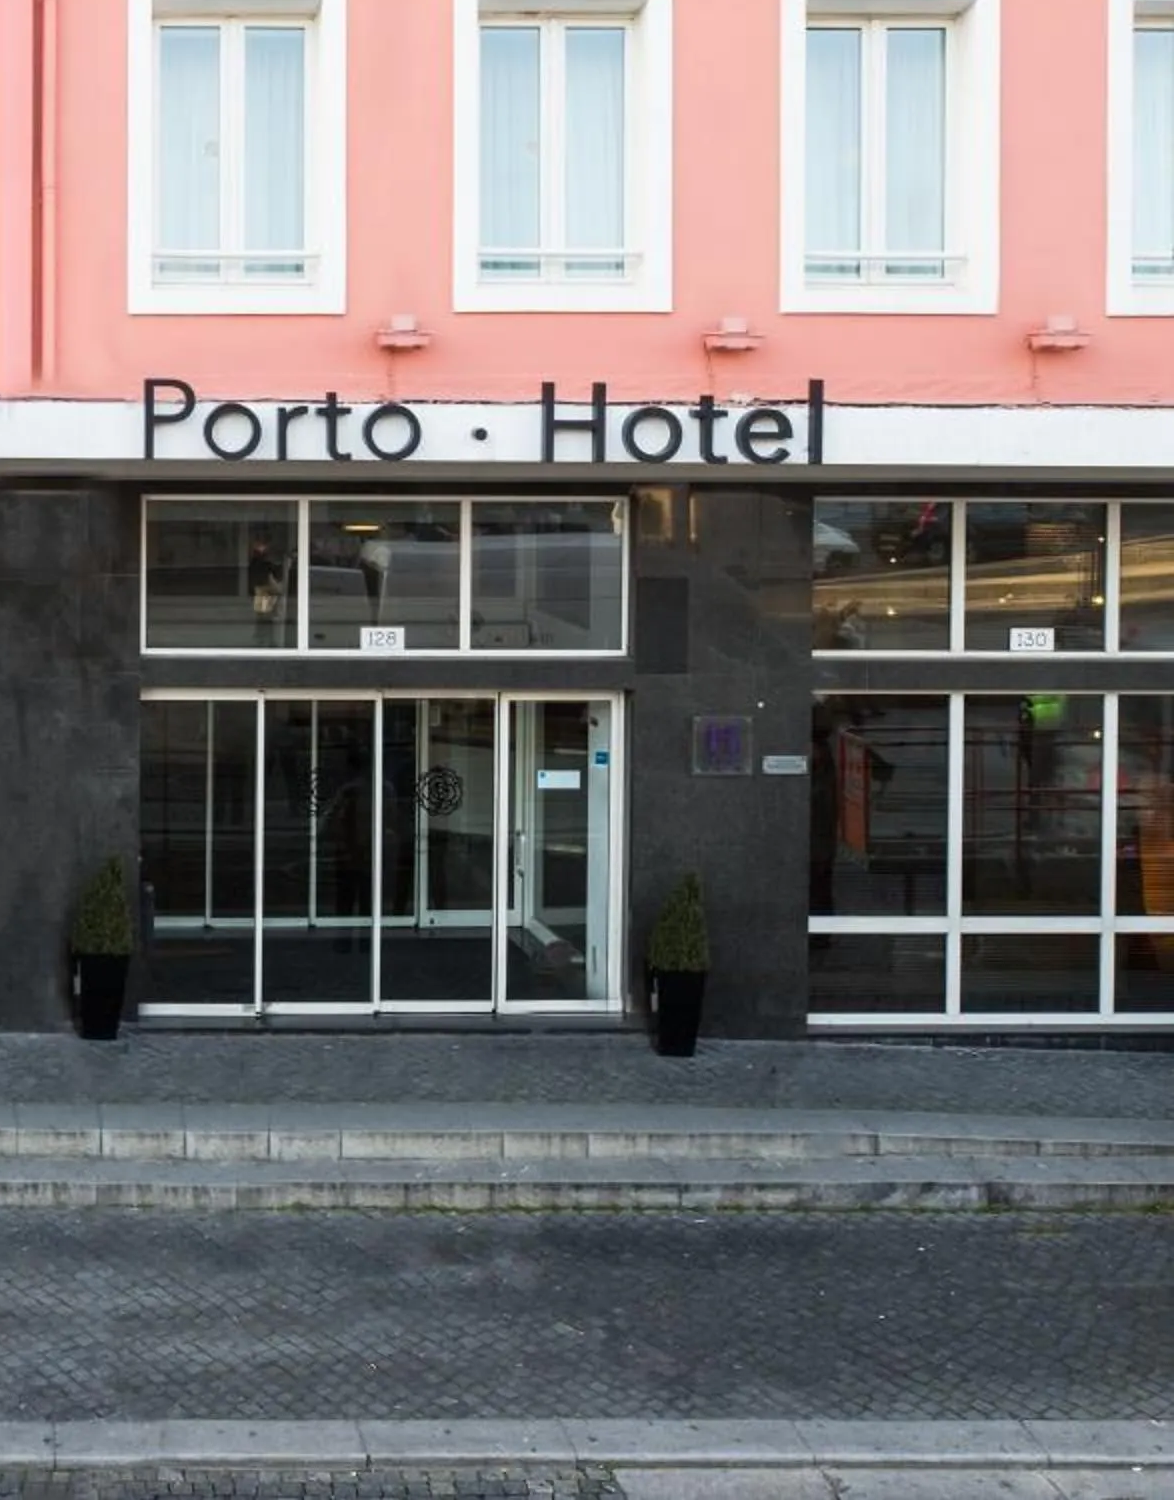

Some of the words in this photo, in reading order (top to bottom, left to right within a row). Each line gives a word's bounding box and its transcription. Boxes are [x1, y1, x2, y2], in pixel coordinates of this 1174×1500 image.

[143, 378, 422, 462] Porto
[541, 378, 825, 465] Hotel
[368, 631, 396, 646] 128
[1017, 631, 1047, 647] 130
